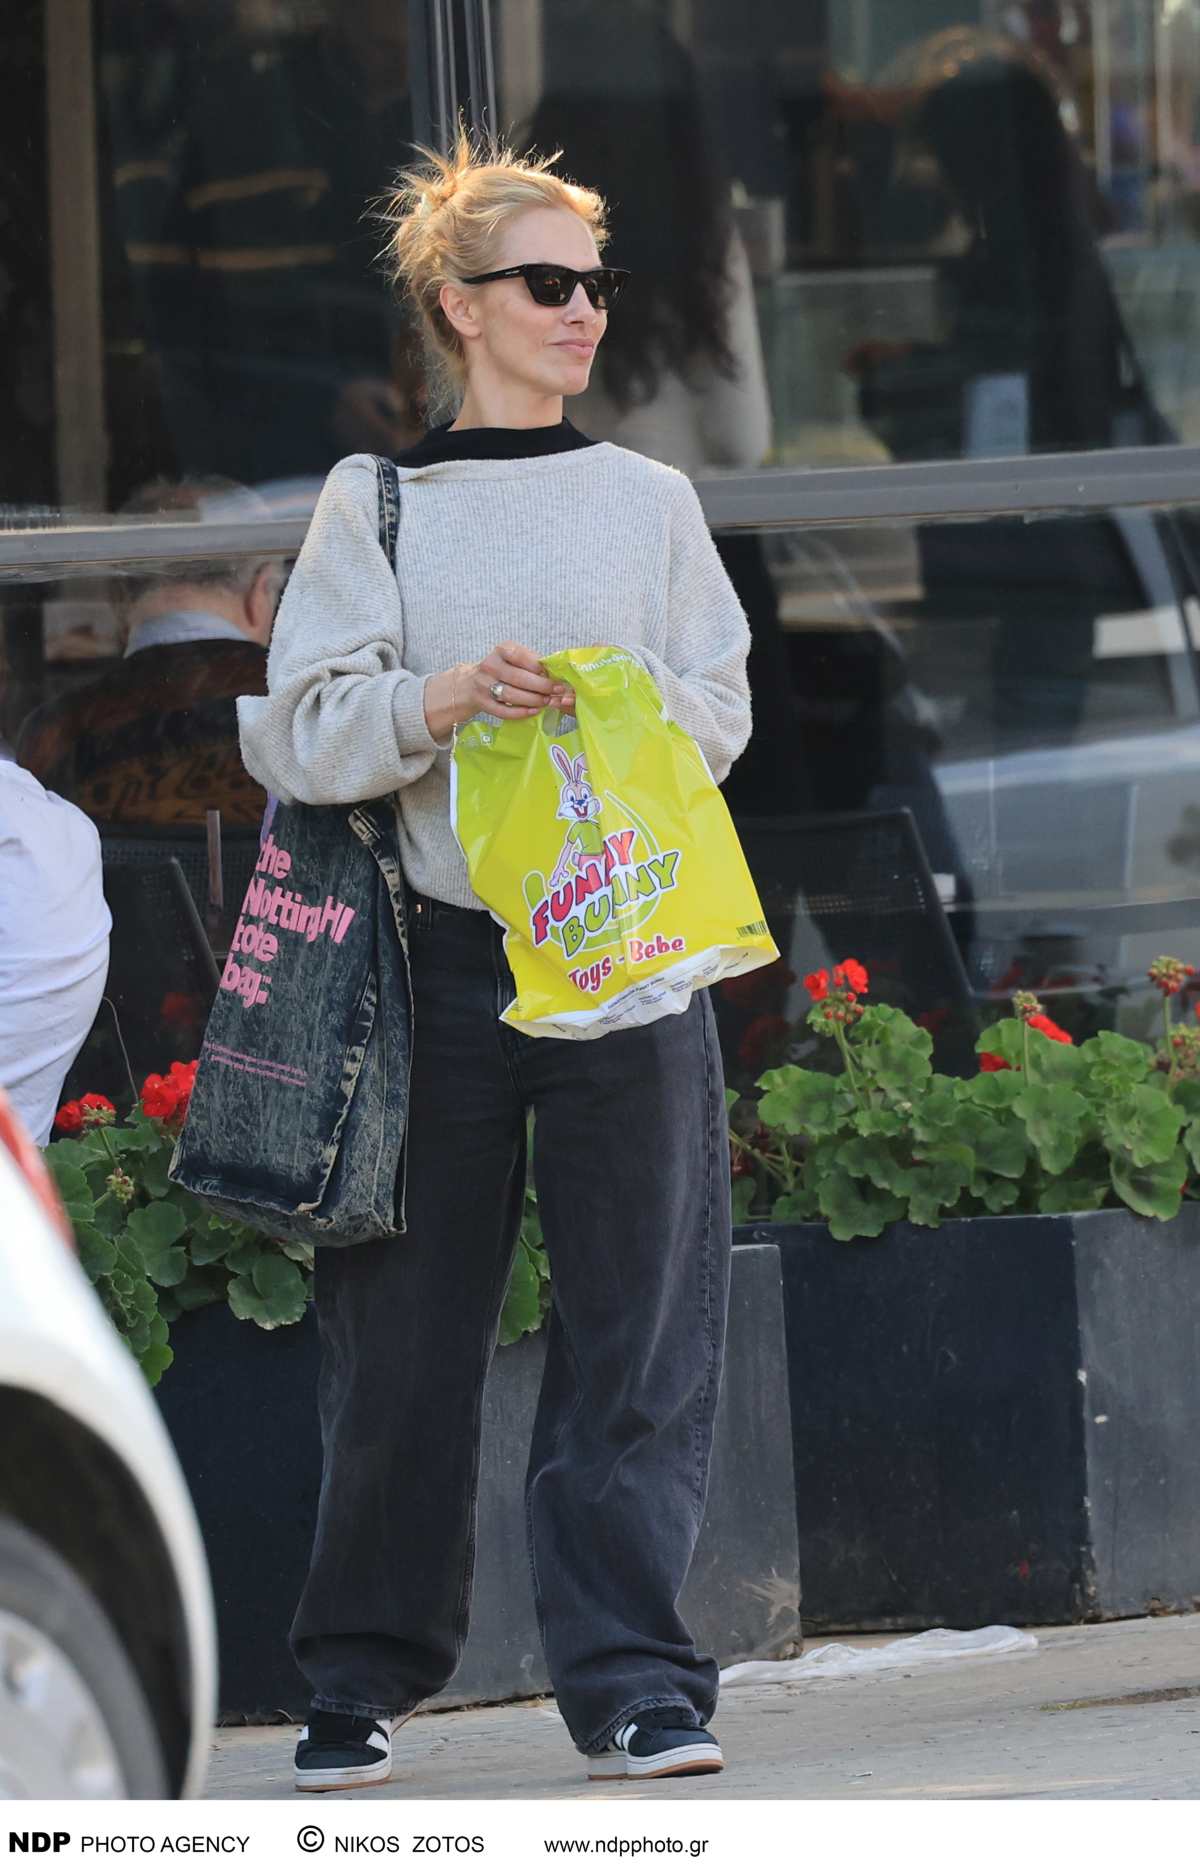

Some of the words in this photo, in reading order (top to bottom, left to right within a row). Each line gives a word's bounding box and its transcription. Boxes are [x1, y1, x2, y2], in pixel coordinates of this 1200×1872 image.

[230, 915, 280, 962] tote
[567, 956, 613, 992] Toys
[629, 935, 685, 962] Bebe
